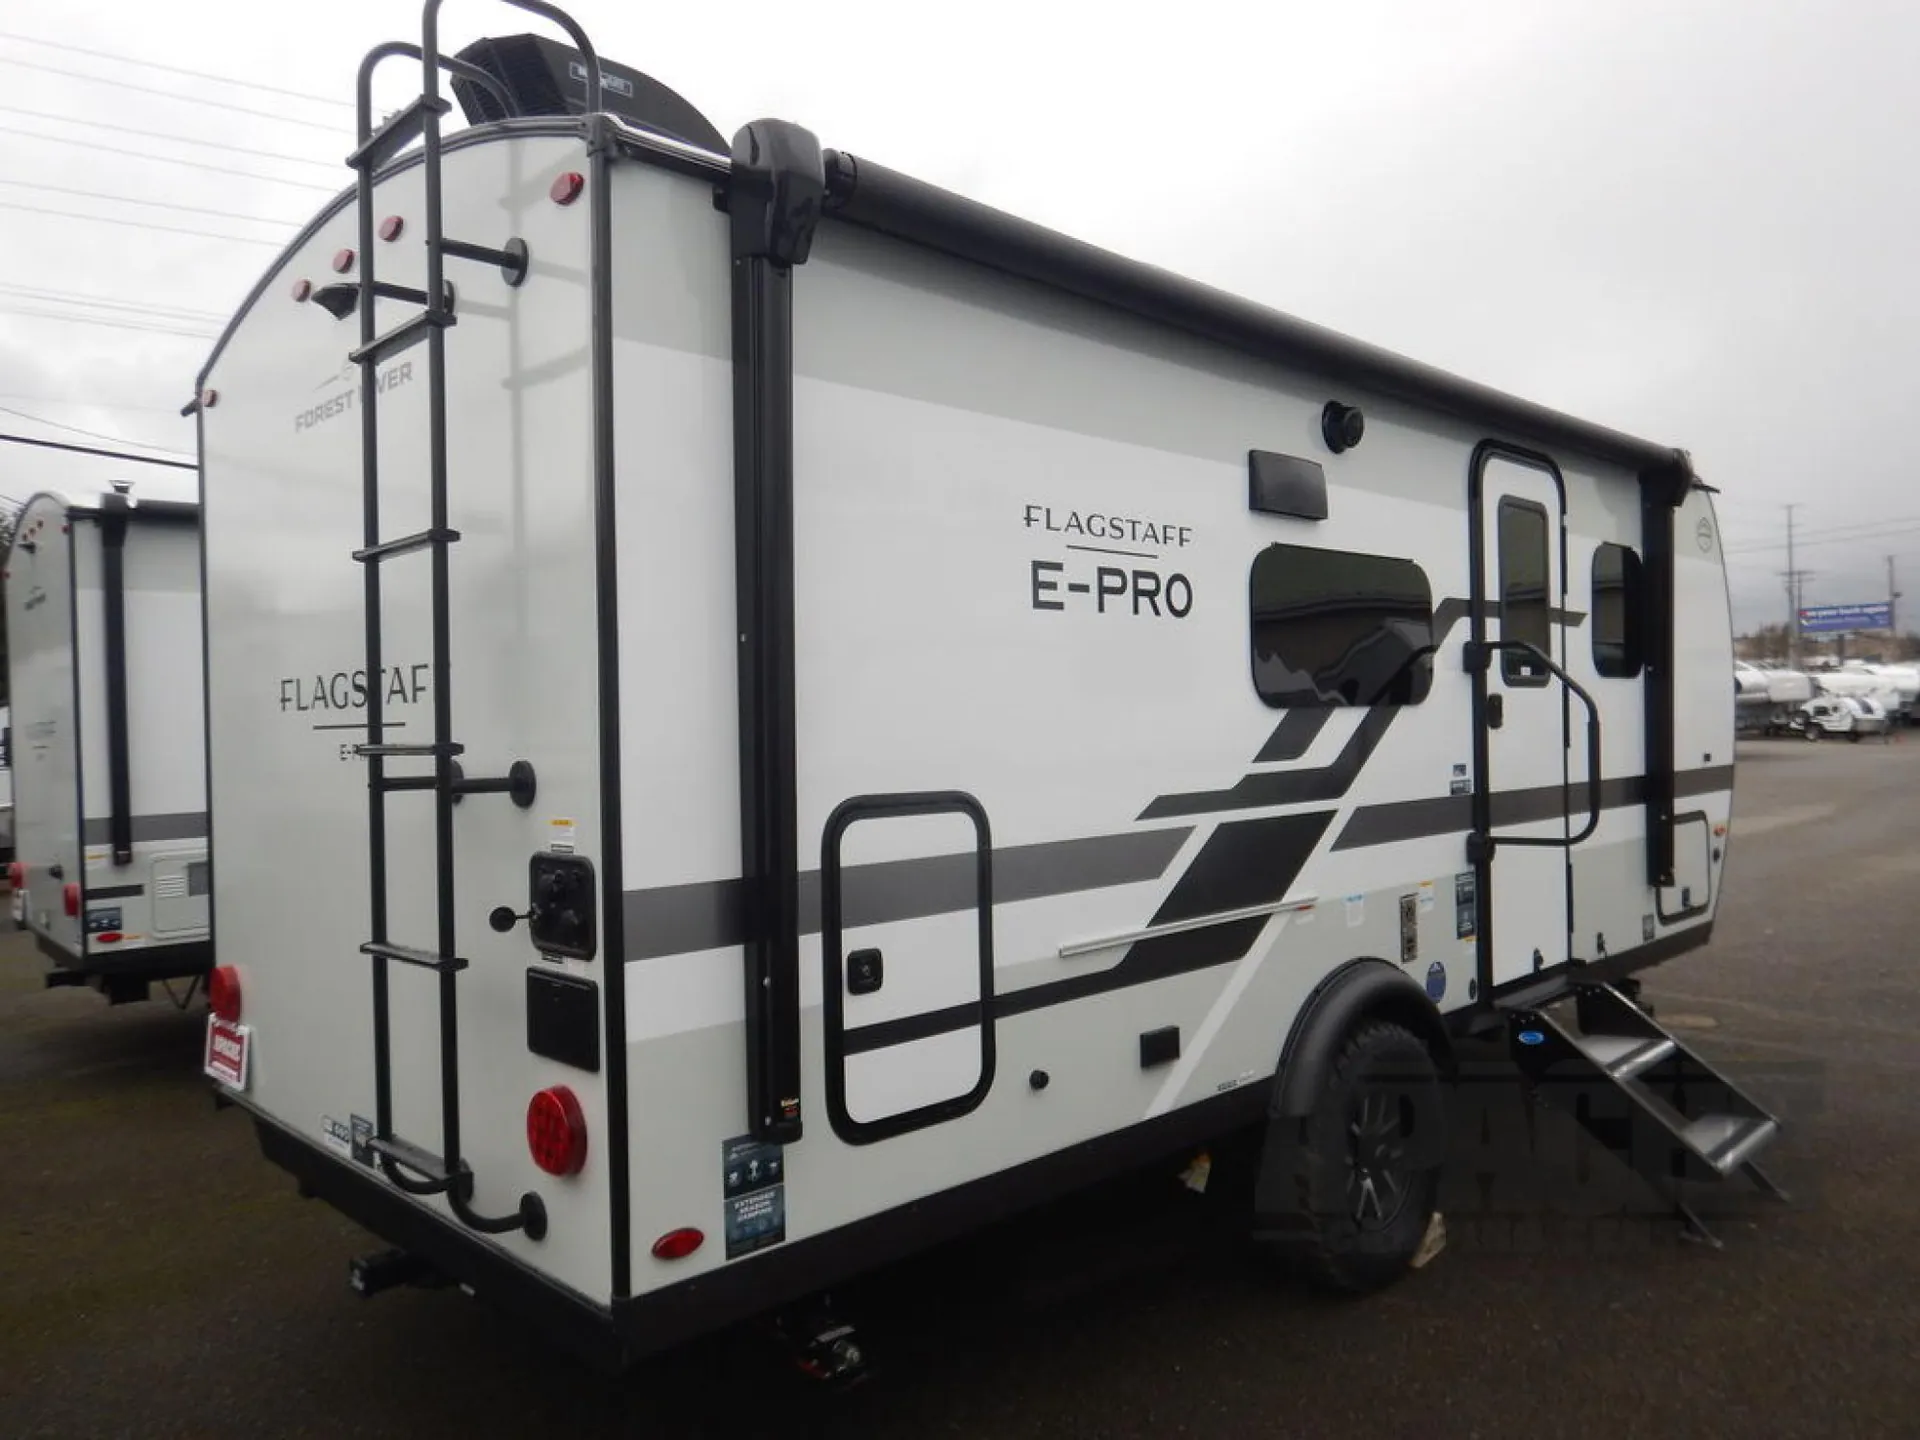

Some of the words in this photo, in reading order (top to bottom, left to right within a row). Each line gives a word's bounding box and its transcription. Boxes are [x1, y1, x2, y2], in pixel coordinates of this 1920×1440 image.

[295, 389, 354, 433] FOREST
[358, 362, 413, 403] VER
[1023, 504, 1193, 546] FLAGSTAFF
[1031, 560, 1193, 618] E-PRO
[280, 663, 430, 711] FLAGSAF
